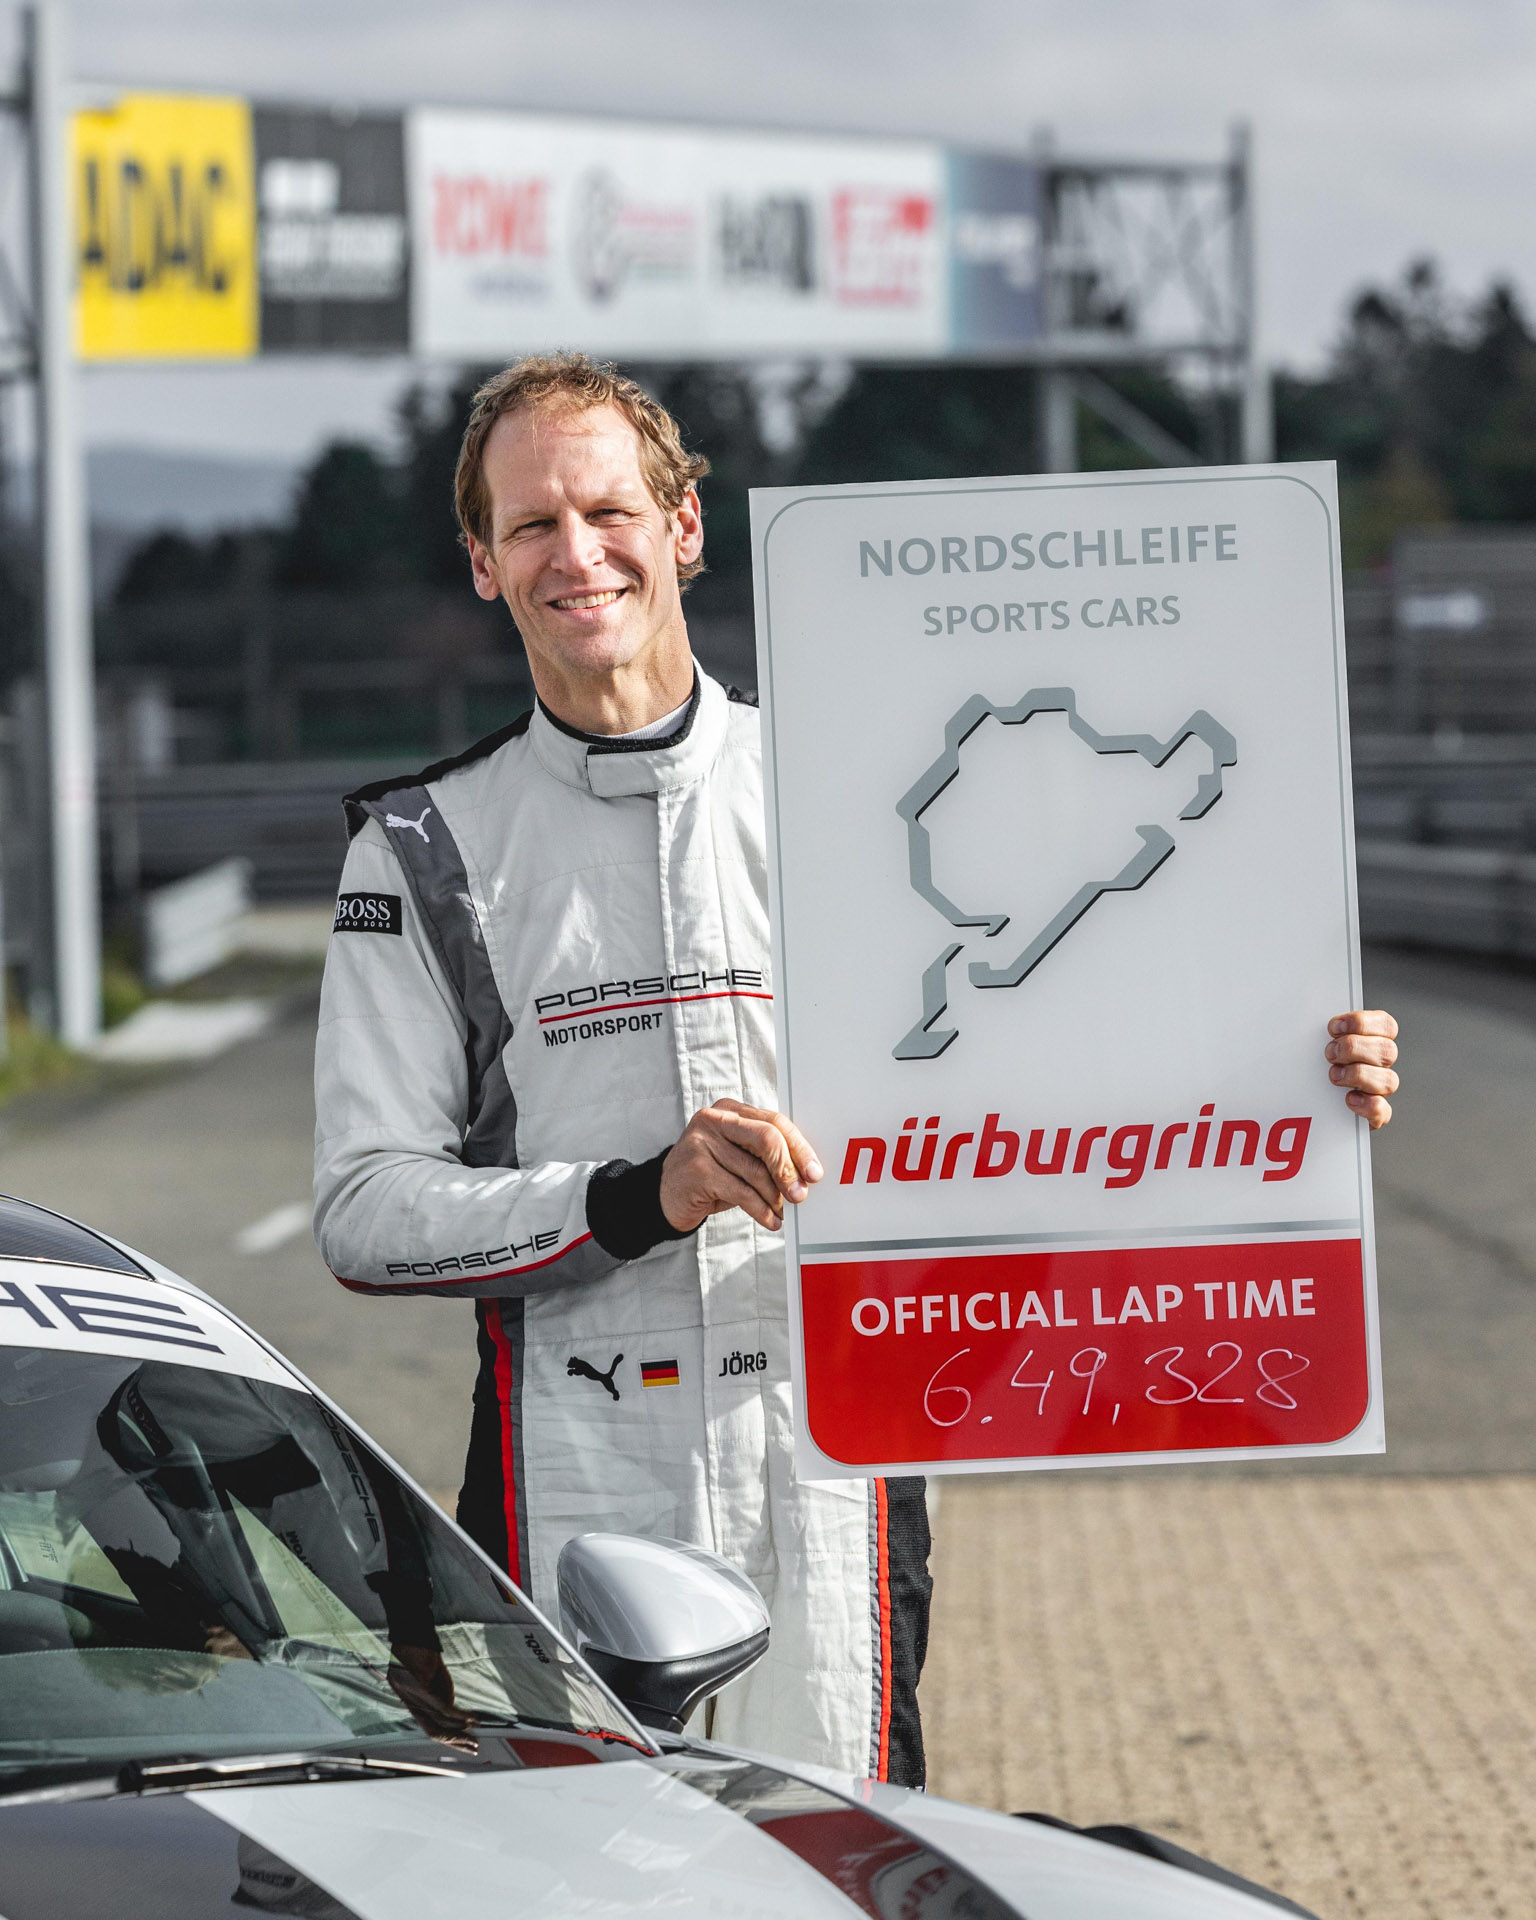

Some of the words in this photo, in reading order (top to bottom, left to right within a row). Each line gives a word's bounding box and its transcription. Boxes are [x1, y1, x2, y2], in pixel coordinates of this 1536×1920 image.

[859, 523, 1239, 578] NORDSCHLEIFE
[923, 600, 1070, 636] SPORTS
[1081, 595, 1181, 629] CARS
[336, 898, 391, 920] BOSS
[534, 968, 762, 1014] PORSCHE
[543, 1012, 663, 1047] MOTORSPORT
[839, 1103, 1312, 1189] nürburgring
[386, 1226, 564, 1277] PORSCHE
[850, 1288, 1079, 1338] OFFICIAL
[1092, 1284, 1184, 1325] LAP
[1193, 1278, 1316, 1322] TIME
[718, 1351, 768, 1377] JÖRG
